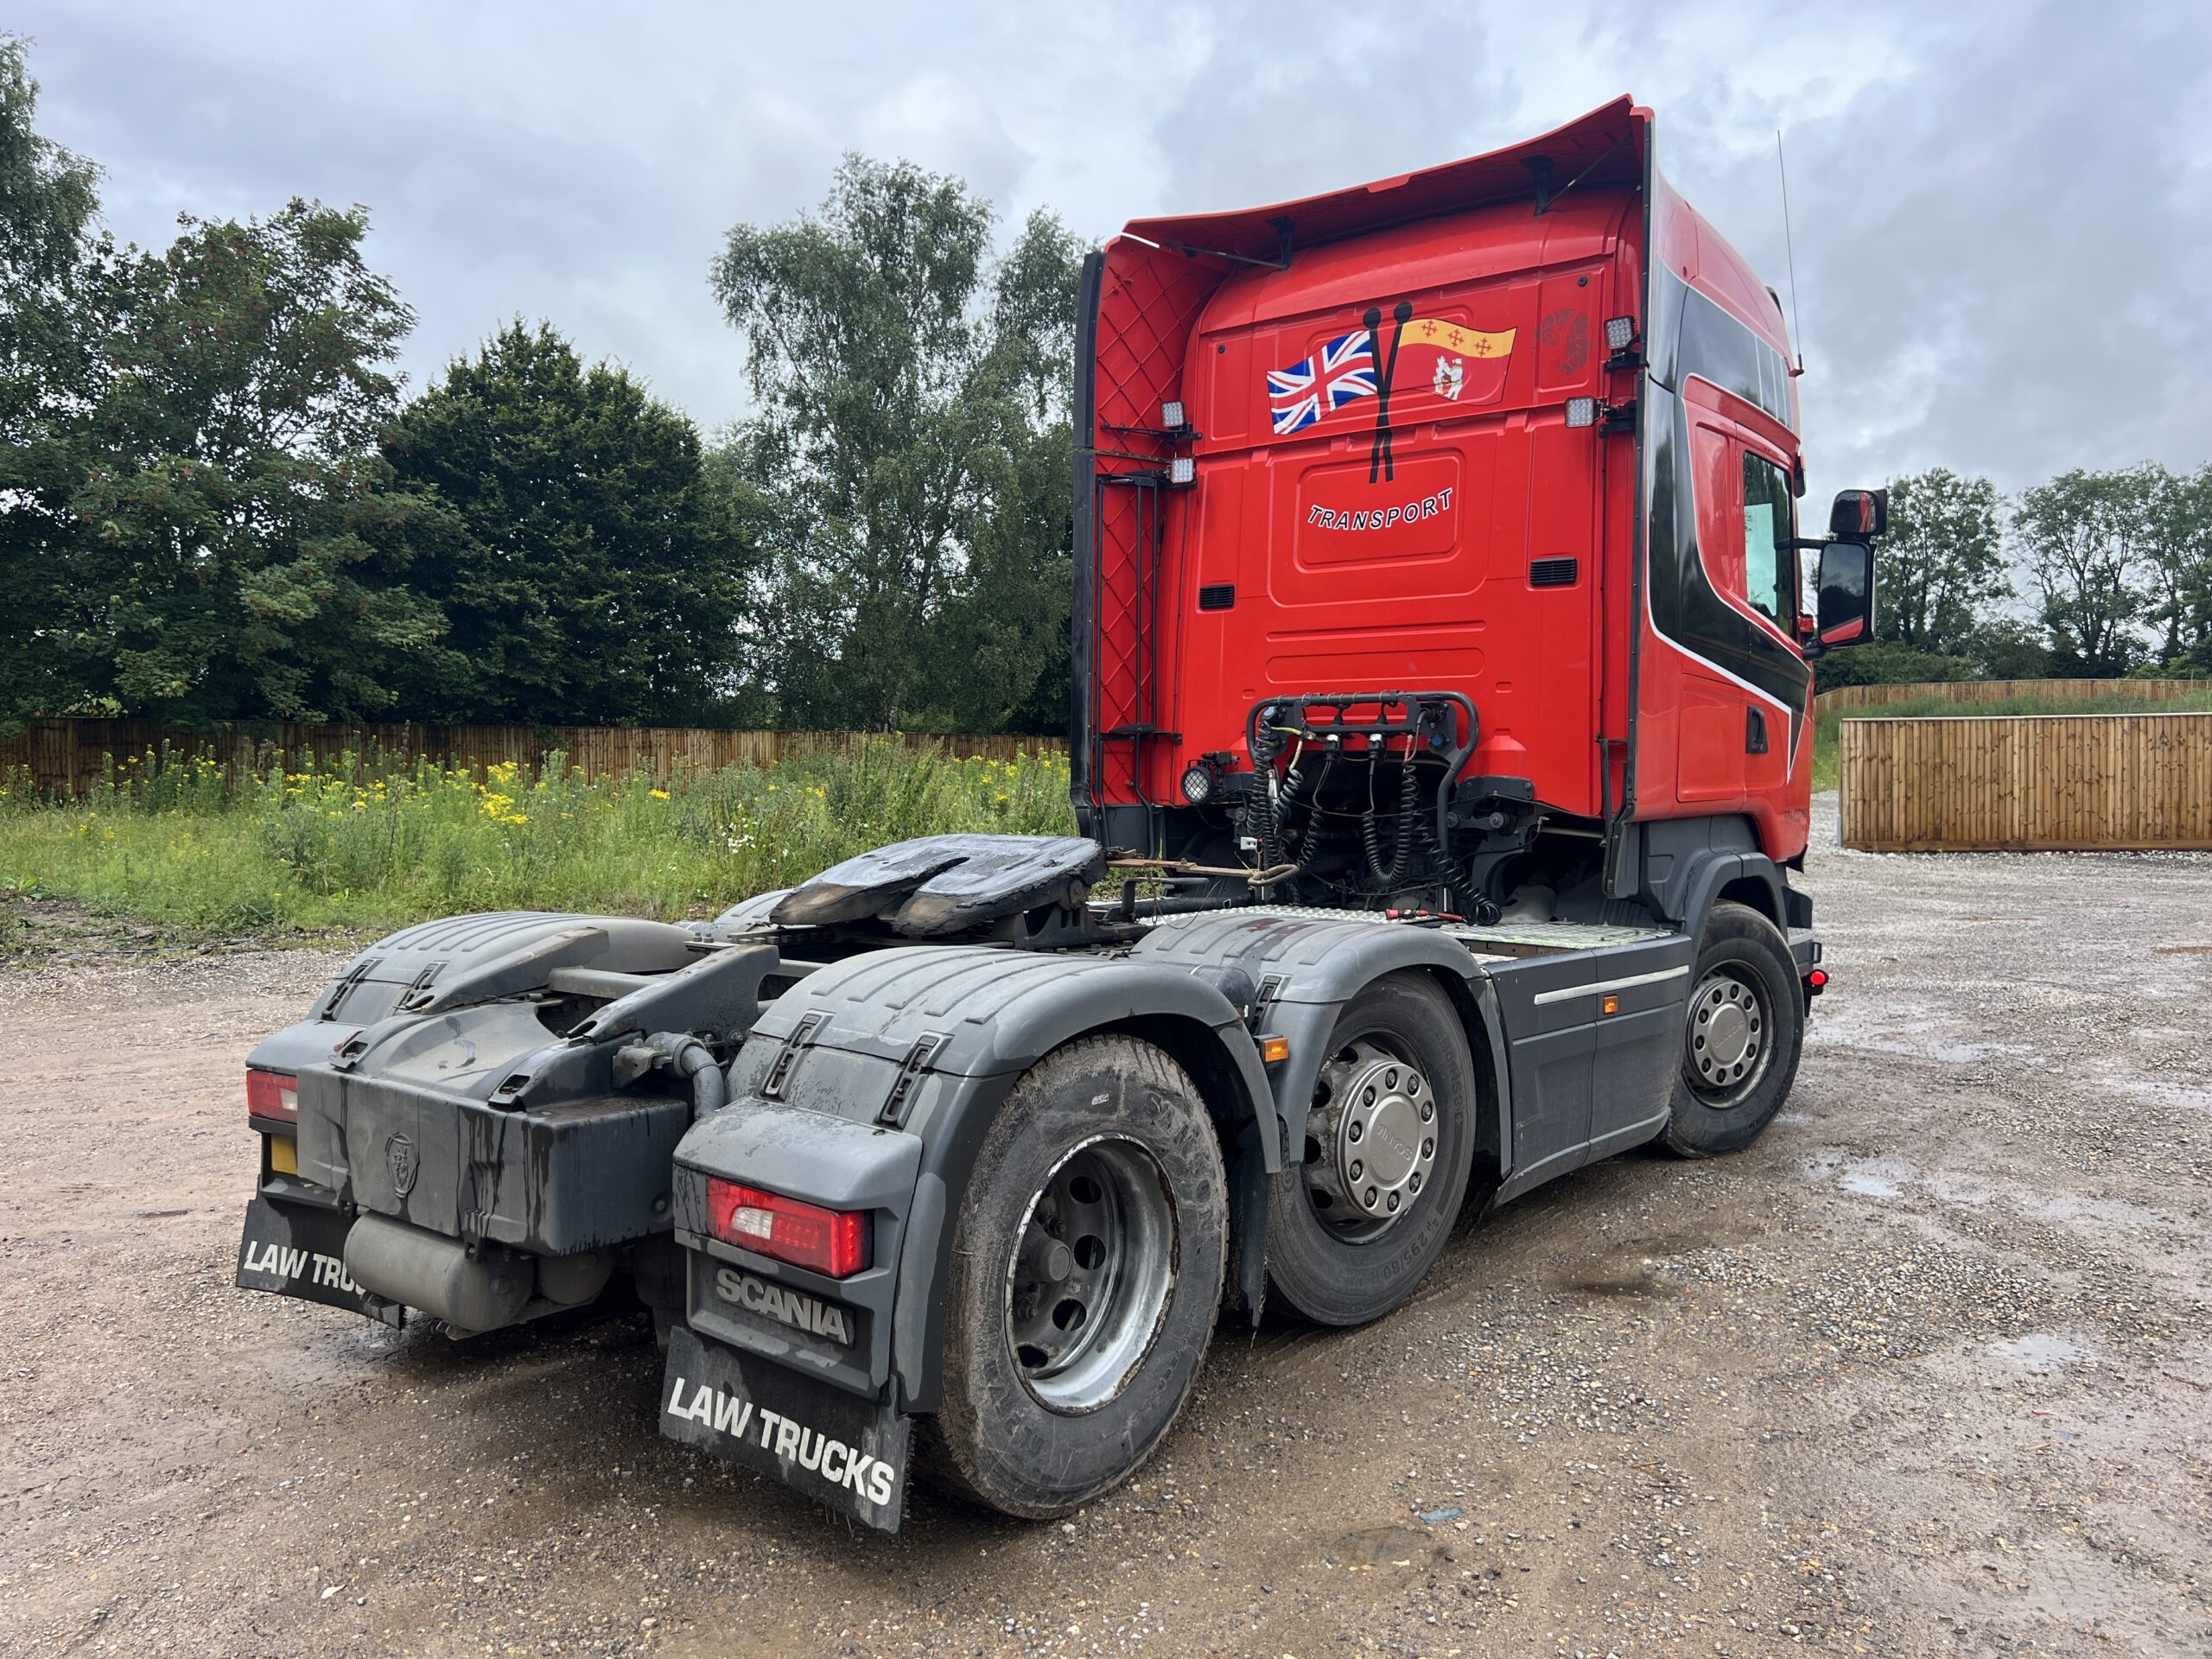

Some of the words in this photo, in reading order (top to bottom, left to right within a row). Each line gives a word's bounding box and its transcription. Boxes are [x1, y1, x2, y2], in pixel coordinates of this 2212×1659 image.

[1307, 487, 1452, 531] TRANSPORT
[1376, 1123, 1414, 1161] SCANIA
[244, 1241, 308, 1279] LAW
[312, 1253, 366, 1294] TRU
[716, 1268, 849, 1344] SCANIA
[667, 1376, 753, 1438] LAW
[760, 1408, 894, 1506] TRUCKS
